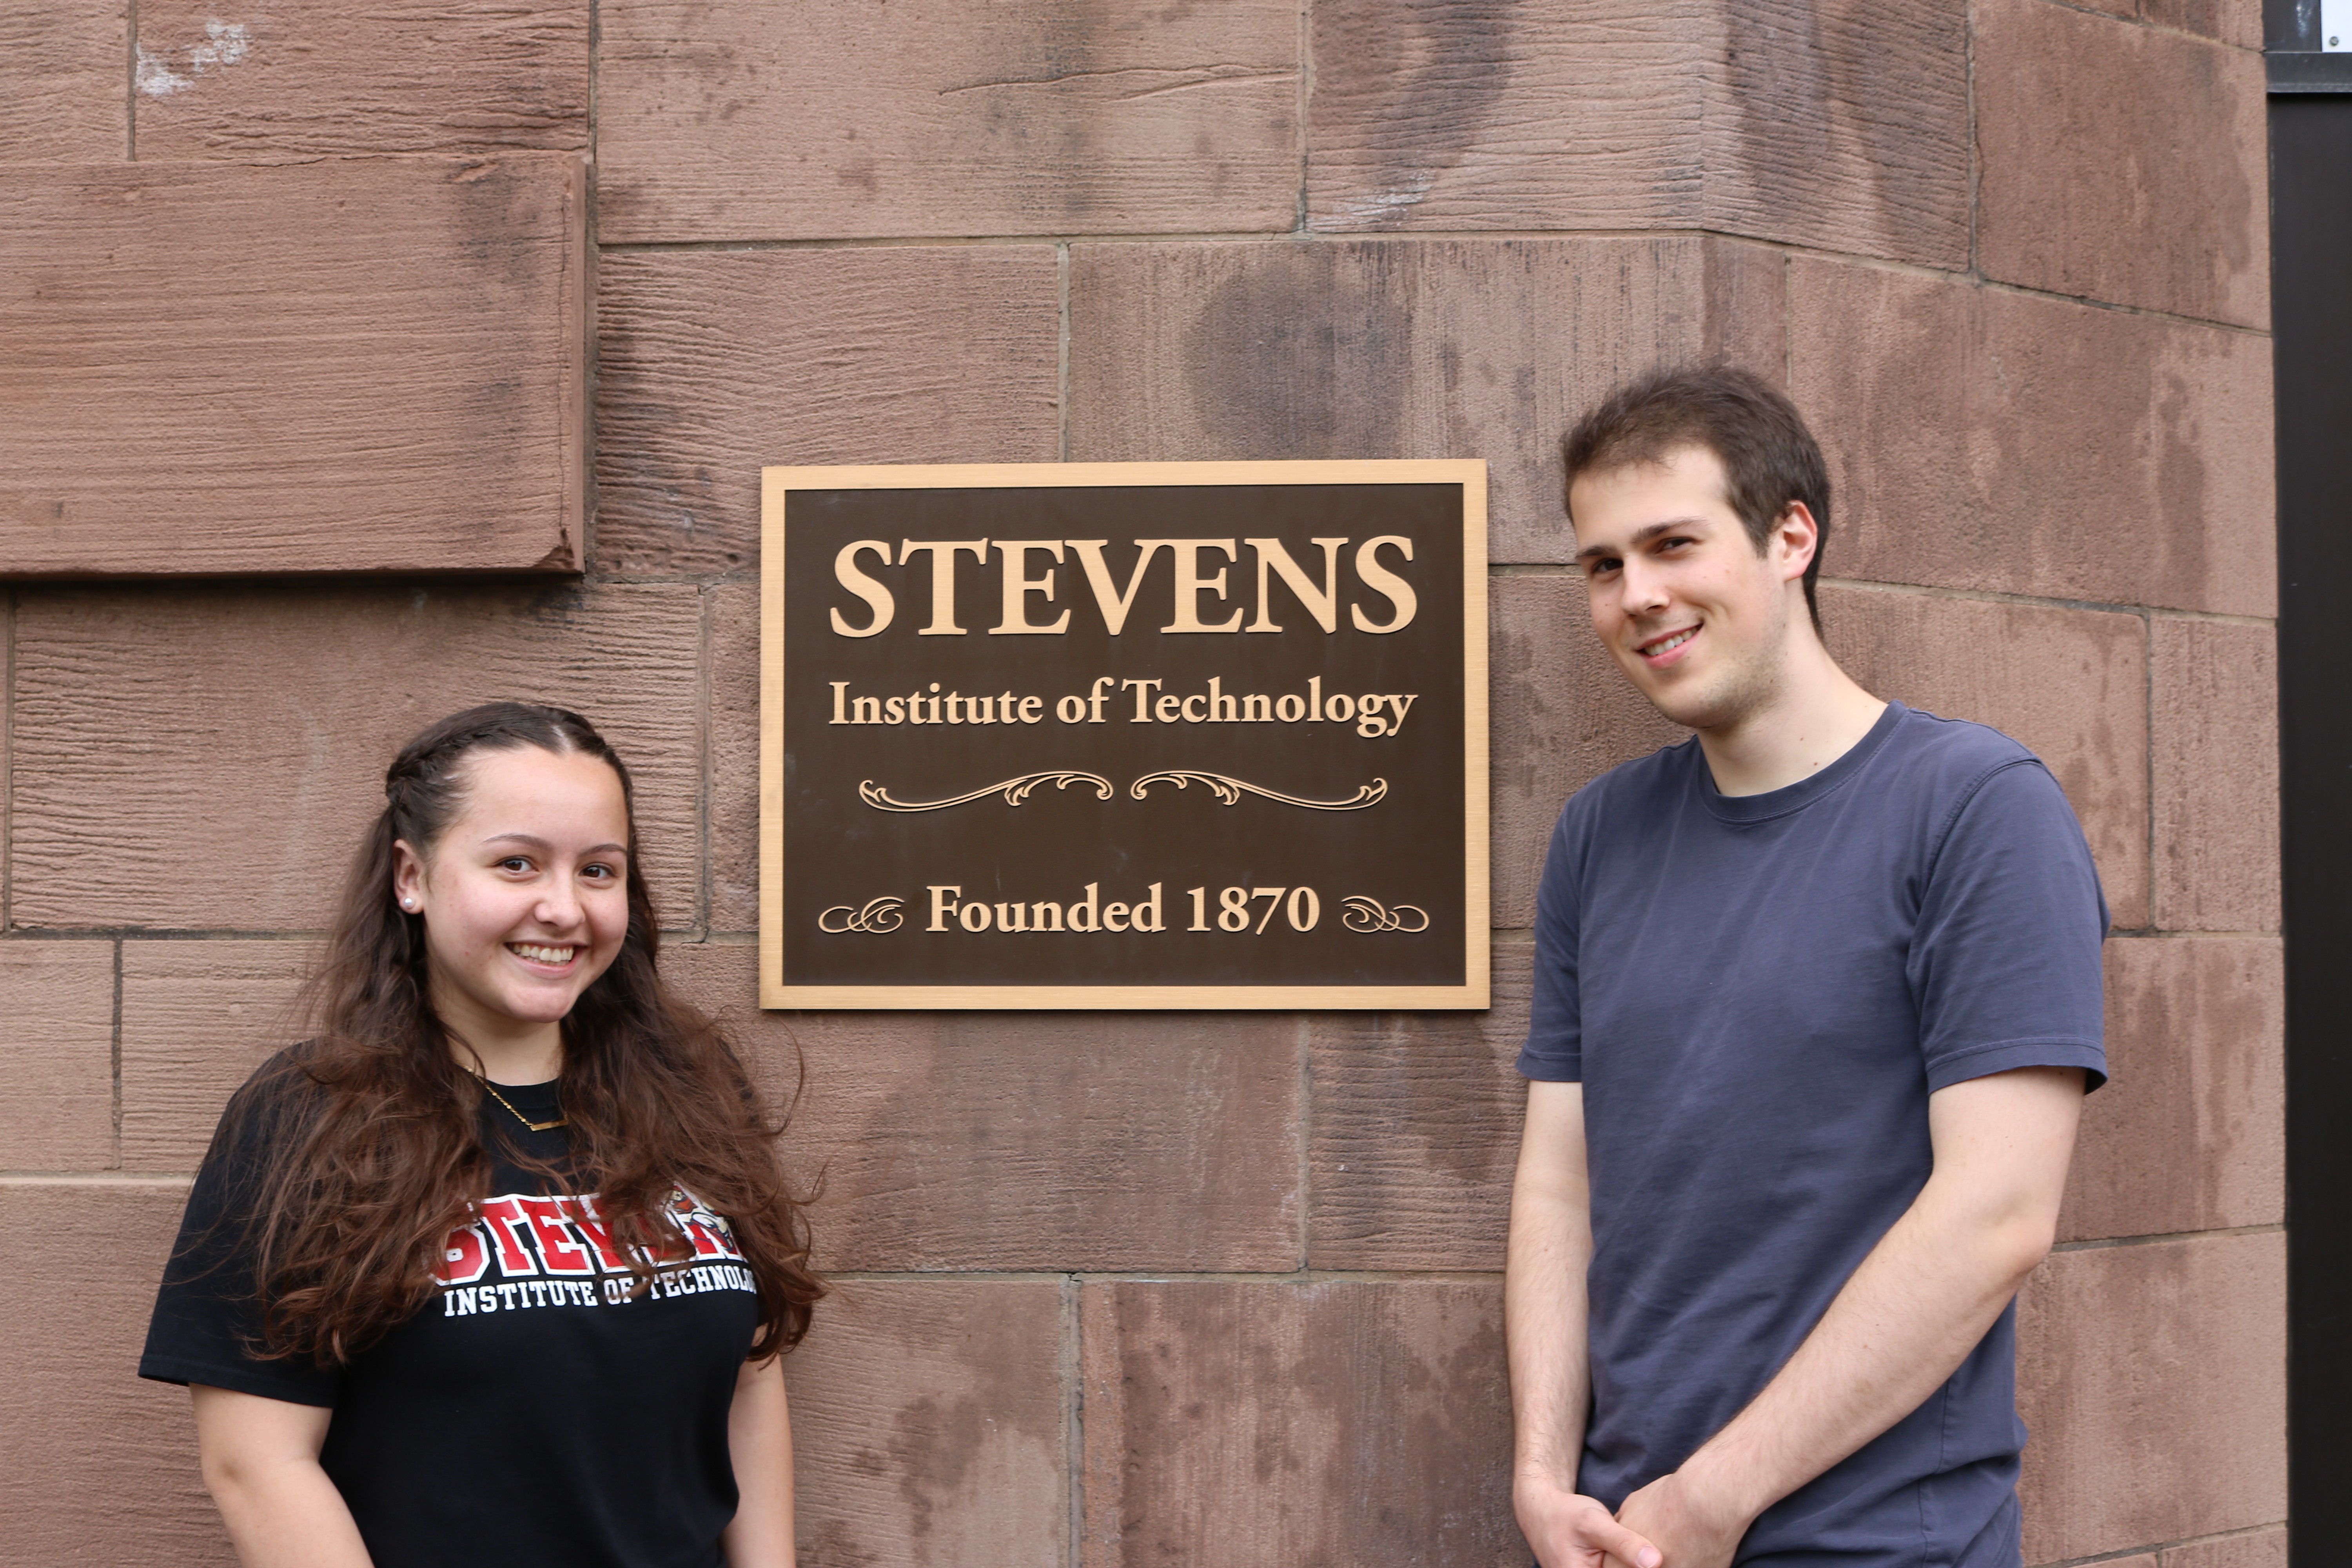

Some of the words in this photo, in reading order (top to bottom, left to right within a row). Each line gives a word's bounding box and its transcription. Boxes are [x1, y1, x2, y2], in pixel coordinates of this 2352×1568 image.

[829, 535, 1417, 638] STEVENS
[828, 681, 1044, 725] Institute
[1056, 677, 1114, 724] of
[1121, 675, 1418, 738] Technology
[925, 882, 1167, 933] Founded
[1187, 885, 1320, 935] 1870
[444, 1280, 599, 1317] INSTITUTE
[604, 1277, 635, 1305] OF
